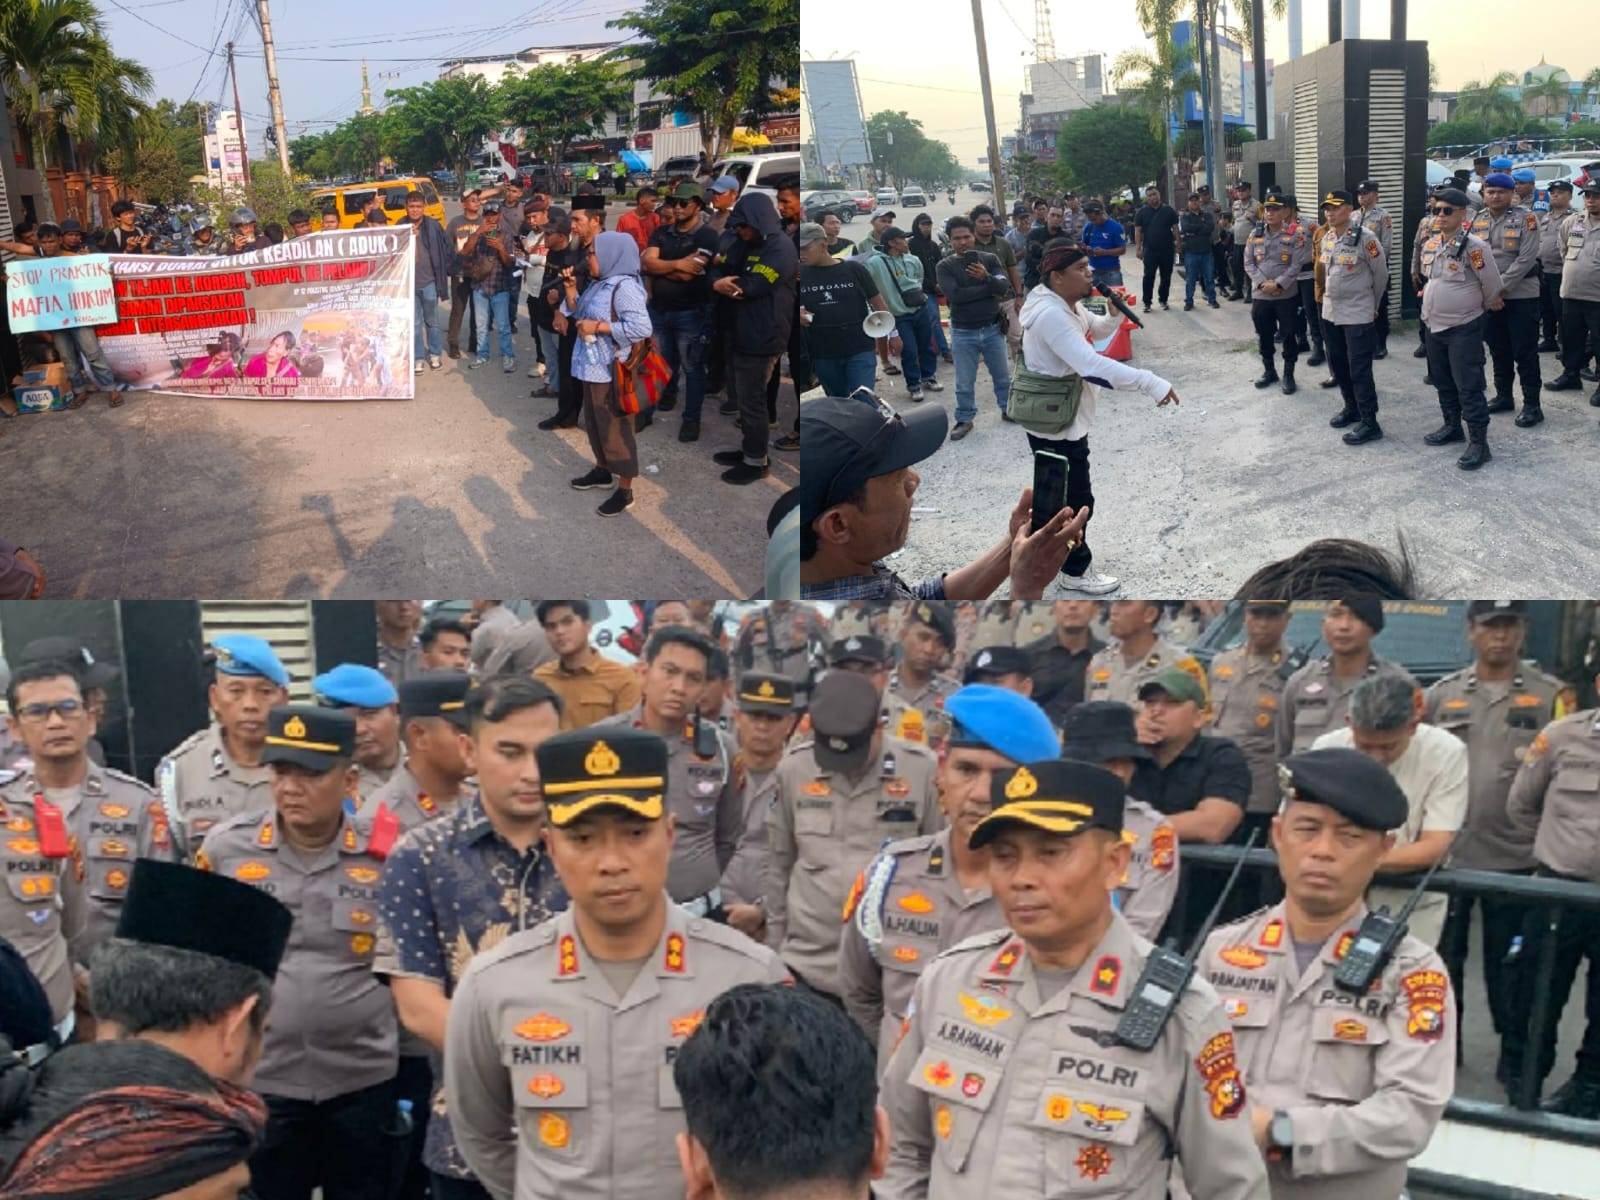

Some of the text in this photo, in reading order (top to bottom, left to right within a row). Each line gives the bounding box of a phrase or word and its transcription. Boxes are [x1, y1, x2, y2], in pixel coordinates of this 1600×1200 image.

[264, 238, 333, 264] KEADILAN
[349, 235, 388, 255] ADUK
[11, 261, 110, 289] STOP PRAKTIK
[252, 265, 304, 287] TUMPUL
[800, 282, 855, 293] GIORDANO
[11, 295, 63, 319] MAFIA
[68, 288, 115, 311] HUKUM
[89, 822, 137, 836] POLRI
[512, 1045, 581, 1065] FATIKH
[1057, 1056, 1139, 1089] POLRI
